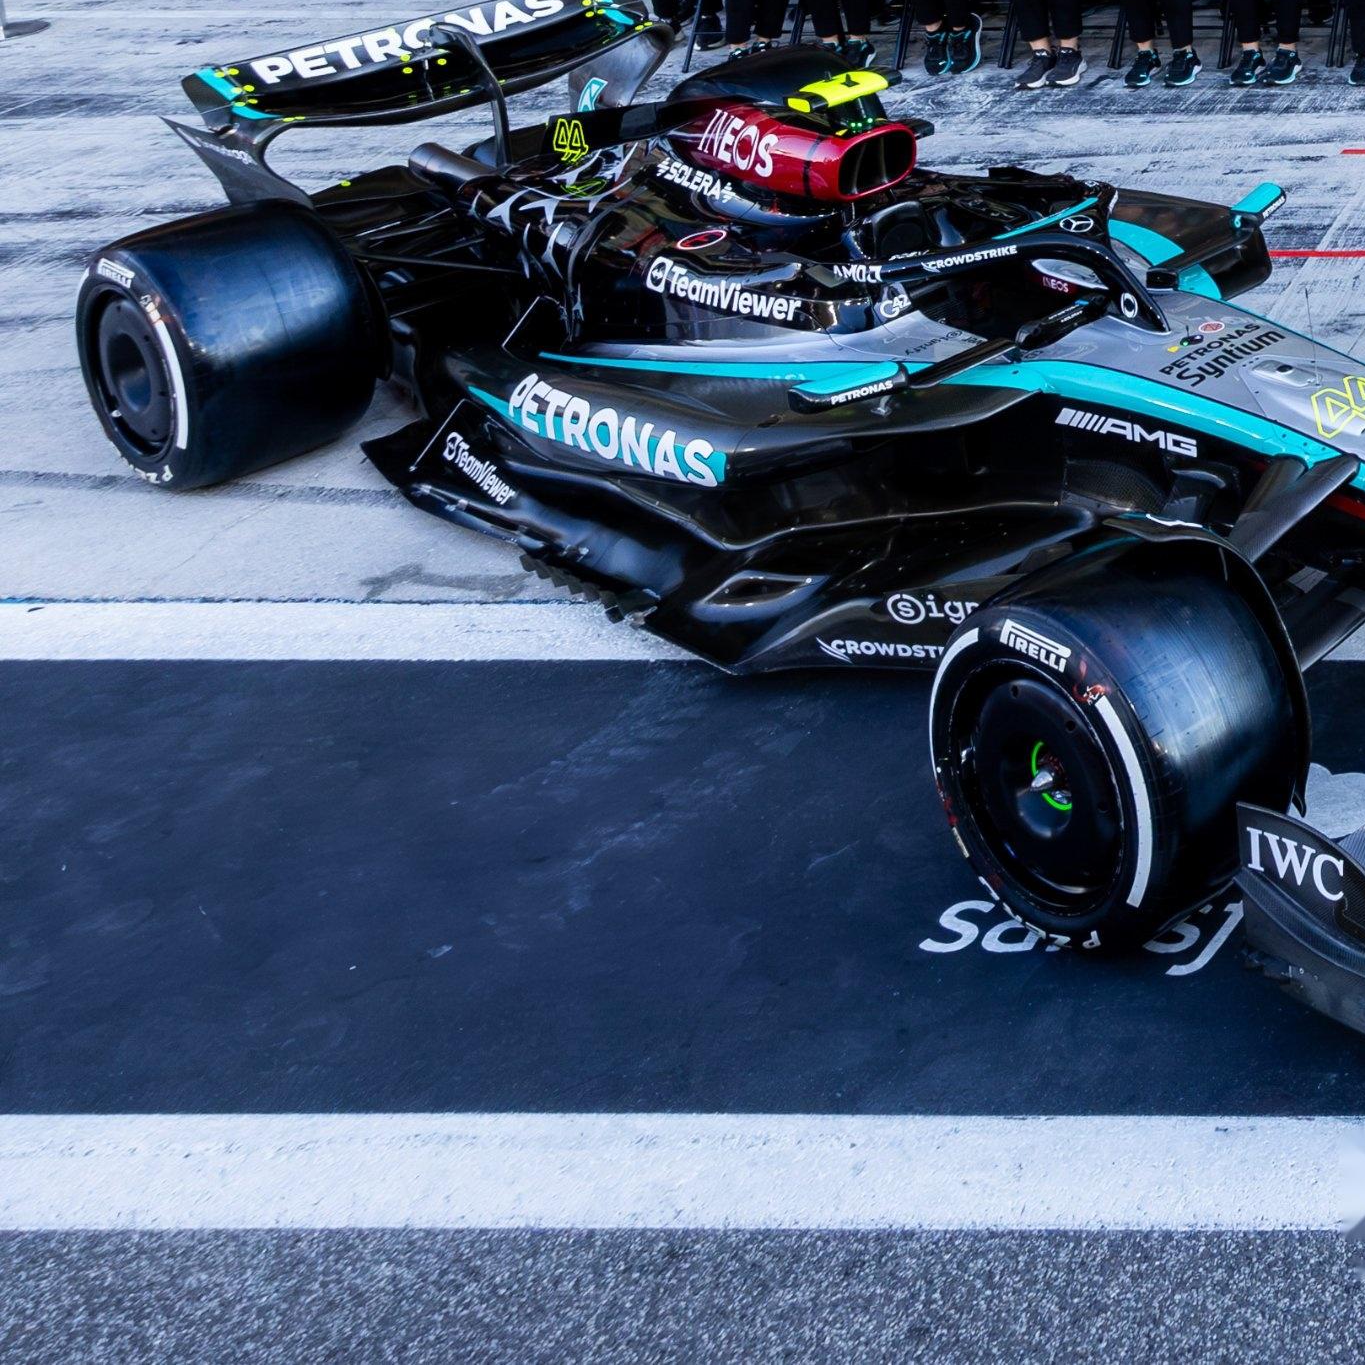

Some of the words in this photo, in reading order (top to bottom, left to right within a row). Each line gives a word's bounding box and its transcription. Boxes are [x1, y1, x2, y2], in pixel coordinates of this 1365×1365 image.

[553, 117, 588, 162] 44
[697, 108, 778, 177] INEOS
[669, 163, 722, 201] SOLERA
[929, 245, 1017, 270] CROWDSTRIKE
[668, 261, 801, 322] TeamViewer
[880, 295, 911, 318] G42
[1159, 322, 1261, 377] PETRONAS
[1177, 328, 1286, 386] Syntium
[831, 379, 894, 405] PETRONAS
[508, 373, 719, 487] PETRONAS
[1100, 419, 1197, 458] AMG
[455, 441, 518, 504] TeamViewer
[1000, 619, 1071, 672] PIRELLI
[1244, 826, 1345, 902] IWC
